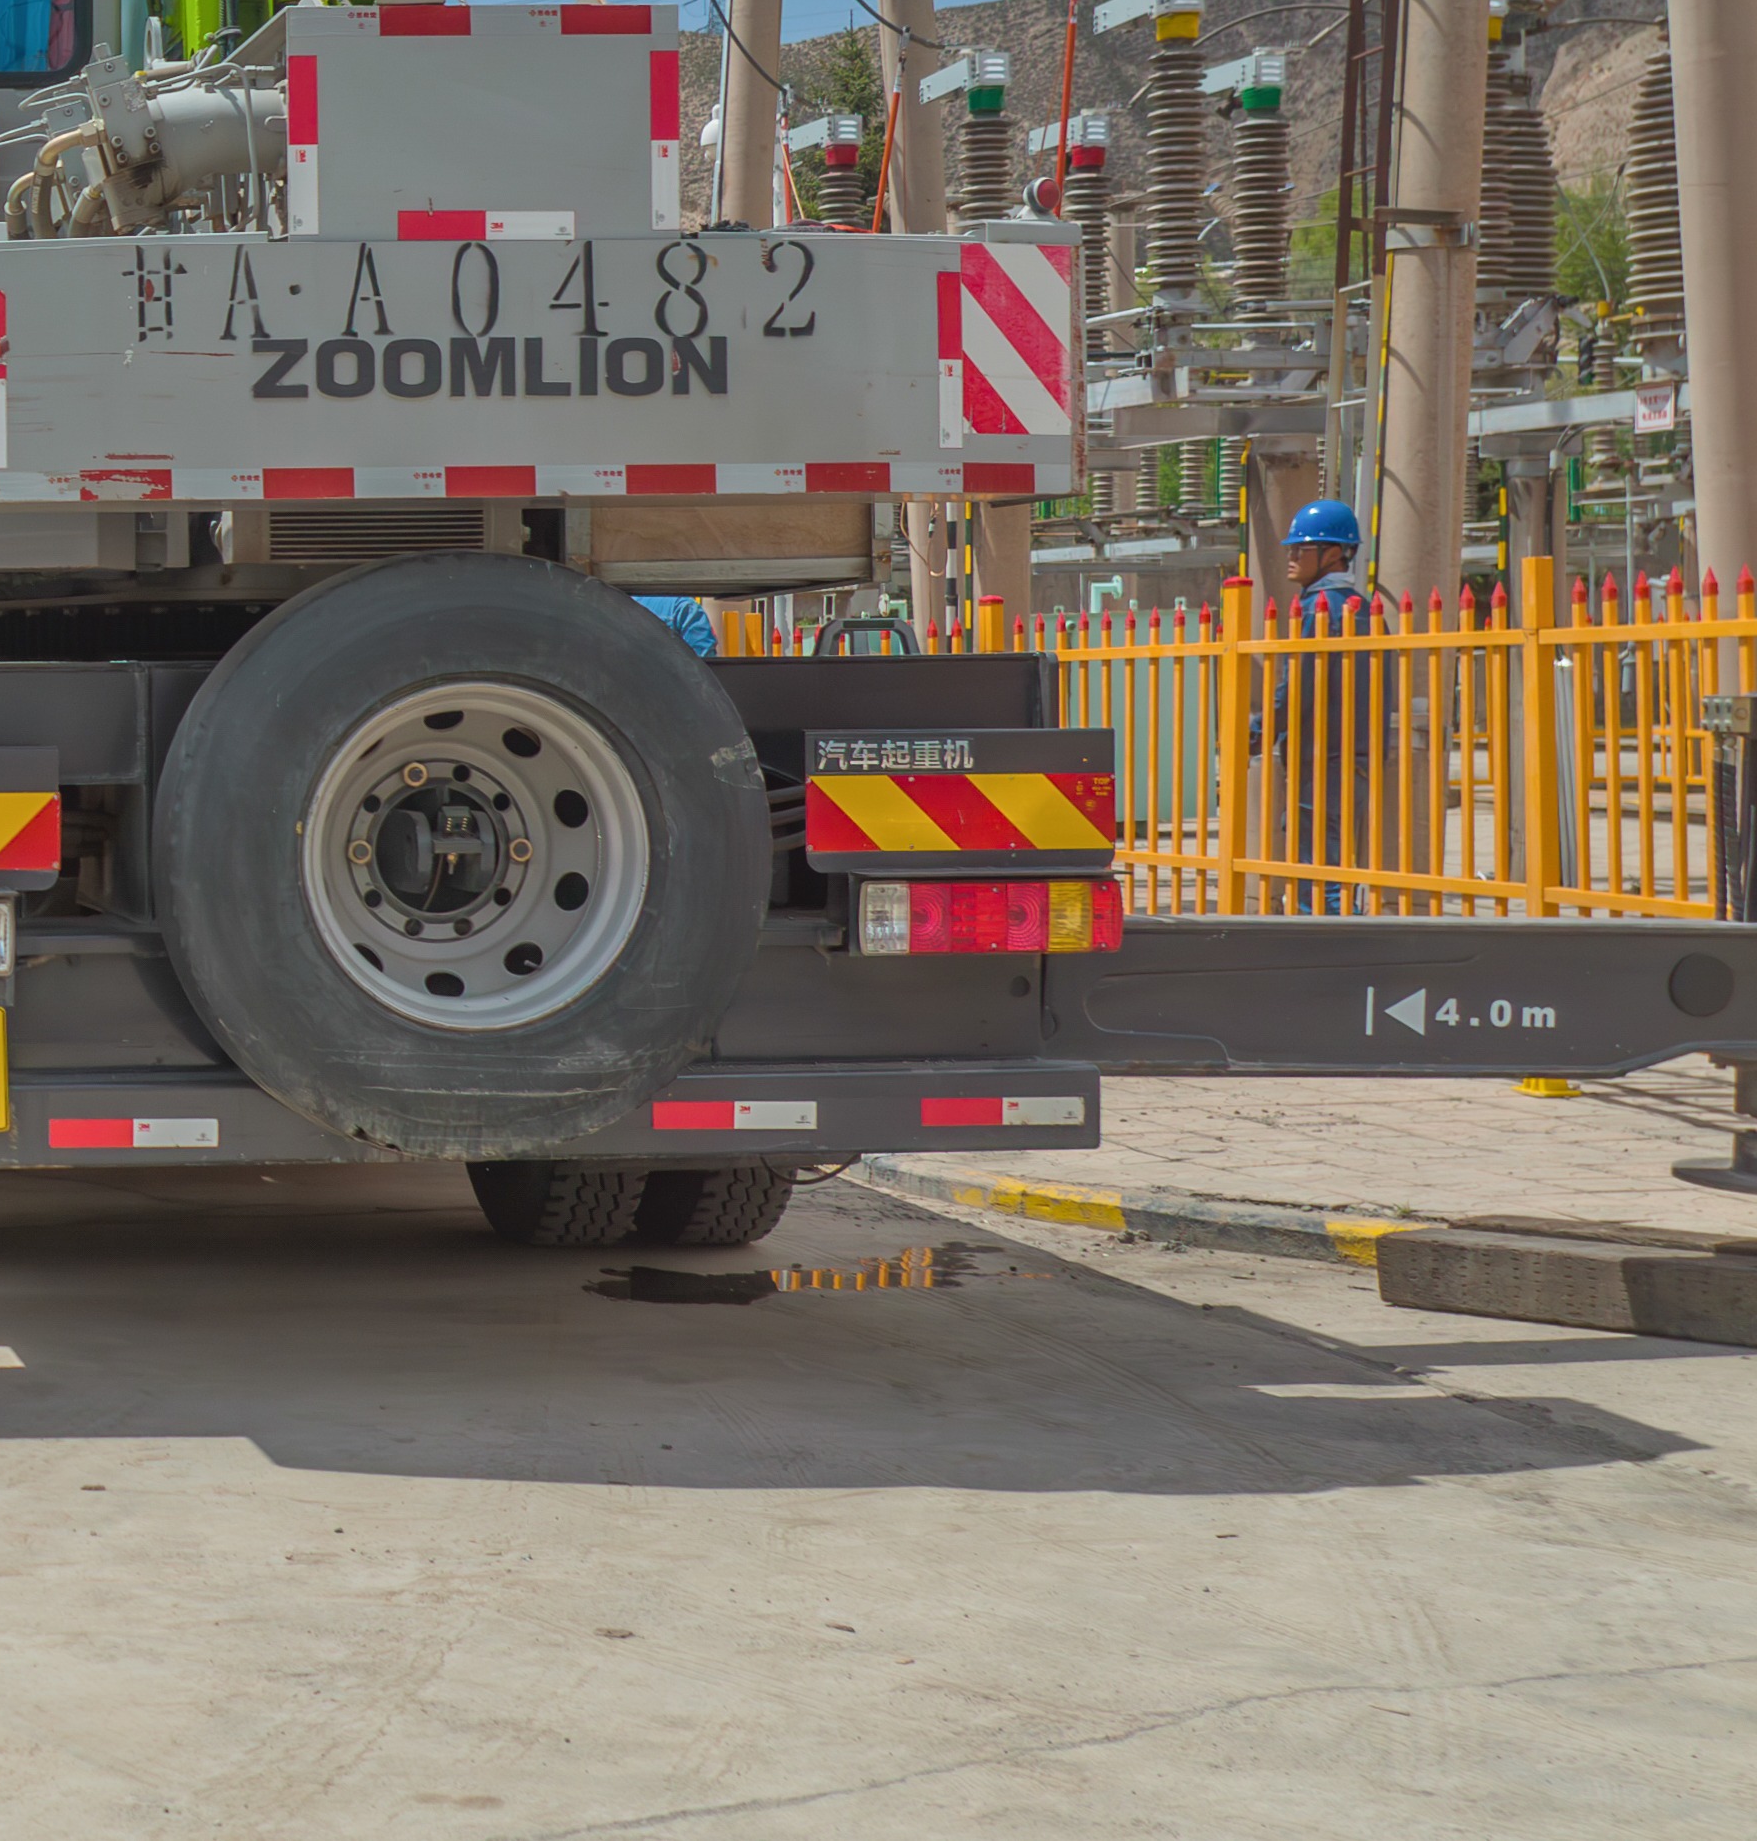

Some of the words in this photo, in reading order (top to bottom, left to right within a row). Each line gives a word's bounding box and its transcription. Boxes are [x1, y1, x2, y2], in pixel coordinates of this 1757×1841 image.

[251, 336, 729, 398] ZOOMLION
[817, 739, 974, 771] 汽车起重机
[1434, 997, 1557, 1029] 4.0m
